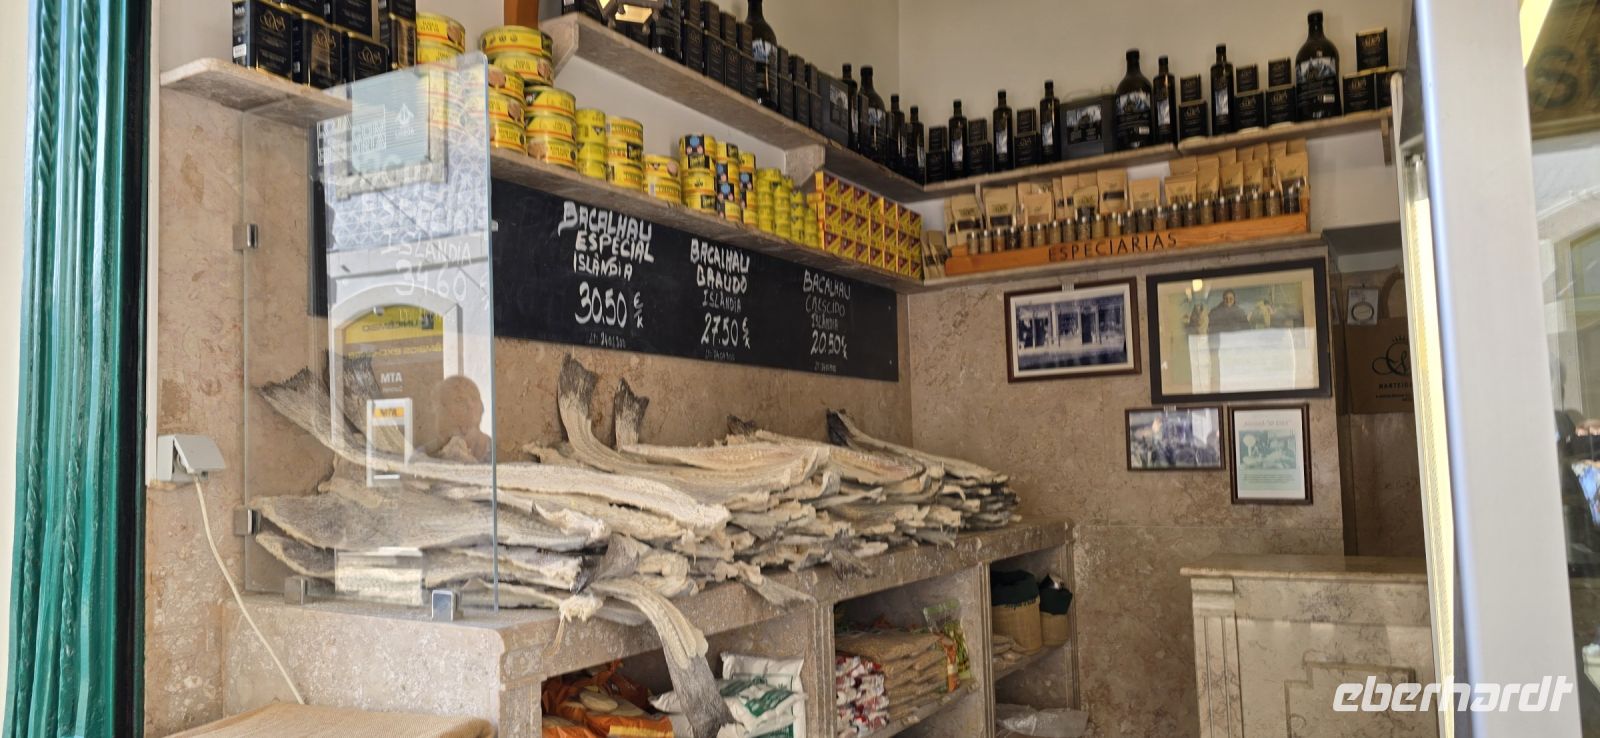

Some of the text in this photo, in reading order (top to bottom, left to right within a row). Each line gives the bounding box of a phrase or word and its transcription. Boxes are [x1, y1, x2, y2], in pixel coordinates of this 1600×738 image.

[557, 201, 652, 241] BACALHAU
[575, 230, 655, 263] ESPECIAL
[1048, 231, 1177, 262] ESPECIARIAS
[803, 268, 851, 301] BACALHAU
[574, 281, 628, 329] 30.50
[701, 312, 739, 347] 27.50
[810, 329, 842, 356] 20.50
